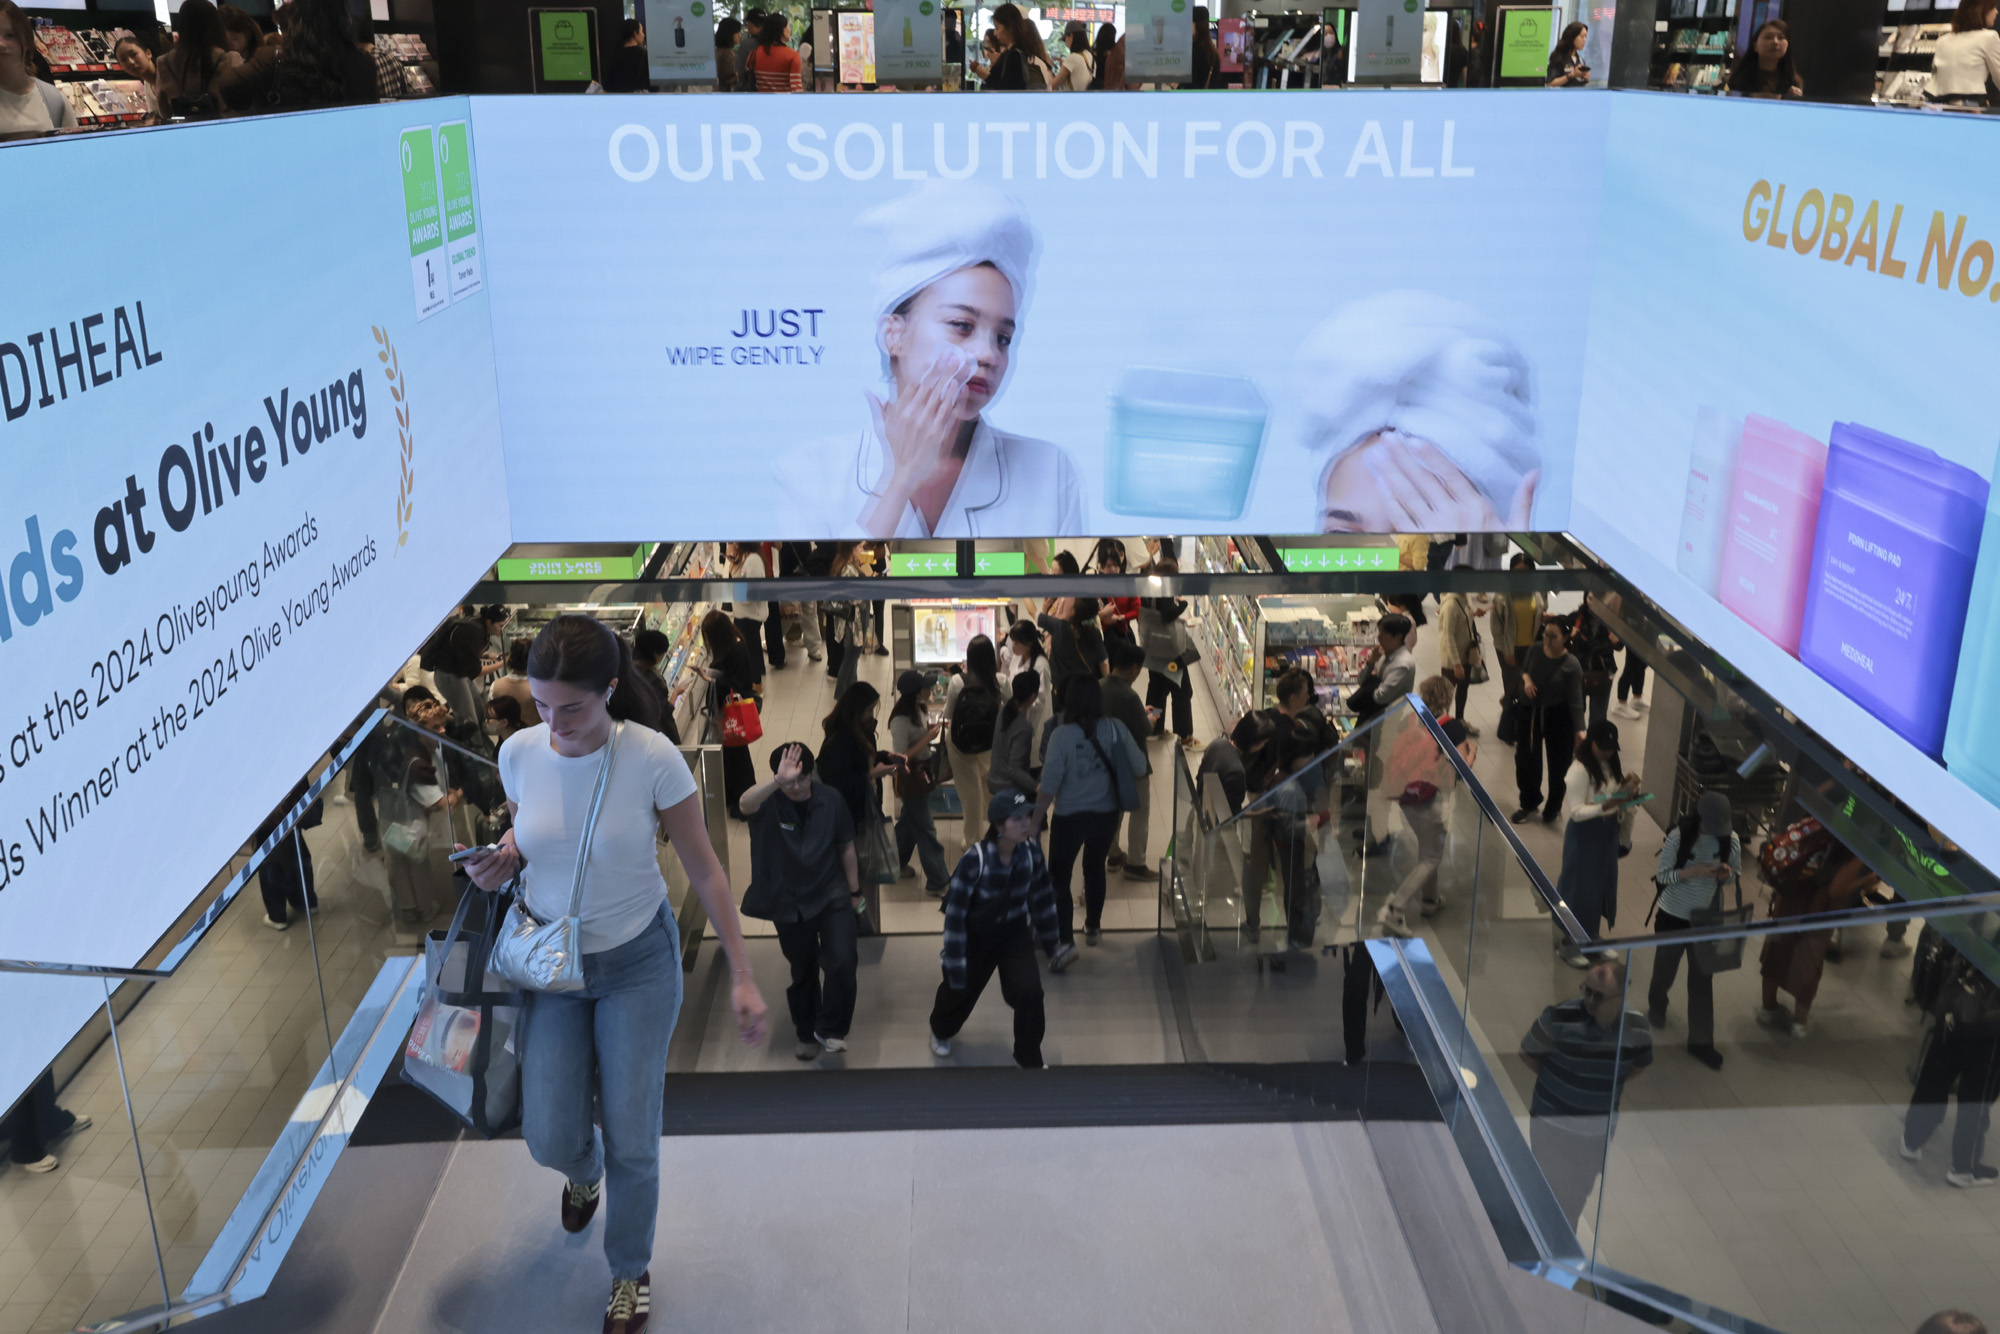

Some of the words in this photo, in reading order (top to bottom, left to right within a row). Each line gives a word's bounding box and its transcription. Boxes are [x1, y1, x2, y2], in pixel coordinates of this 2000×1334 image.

[608, 123, 764, 183] OUR
[786, 120, 1159, 182] SOLUTION
[1184, 120, 1325, 179] FOR
[1344, 119, 1475, 178] ALL
[409, 209, 423, 225] OLIVE
[422, 204, 437, 220] YOUNG
[448, 209, 473, 232] AWARDS
[1742, 178, 1907, 280] GLOBAL
[412, 219, 439, 246] AWARDS
[730, 308, 826, 338] JUST
[666, 346, 726, 367] WIPE
[731, 345, 825, 366] GENTLY
[0, 514, 84, 643] ds
[94, 474, 156, 575] at
[158, 421, 268, 532] Olive
[263, 367, 367, 467] Young
[10, 722, 44, 768] at
[44, 691, 89, 742] the
[91, 628, 154, 708] 2024
[156, 563, 261, 655] Oliveyoung
[263, 511, 319, 579] Awards
[1840, 641, 1874, 675] MEDIHEAL
[25, 756, 120, 855] Winner
[126, 728, 152, 773] at
[152, 704, 188, 745] the
[189, 648, 239, 720] 2024
[240, 620, 282, 672] Olive
[282, 579, 330, 636] Young
[331, 535, 377, 597] Awards
[408, 1040, 425, 1058] OLIVE
